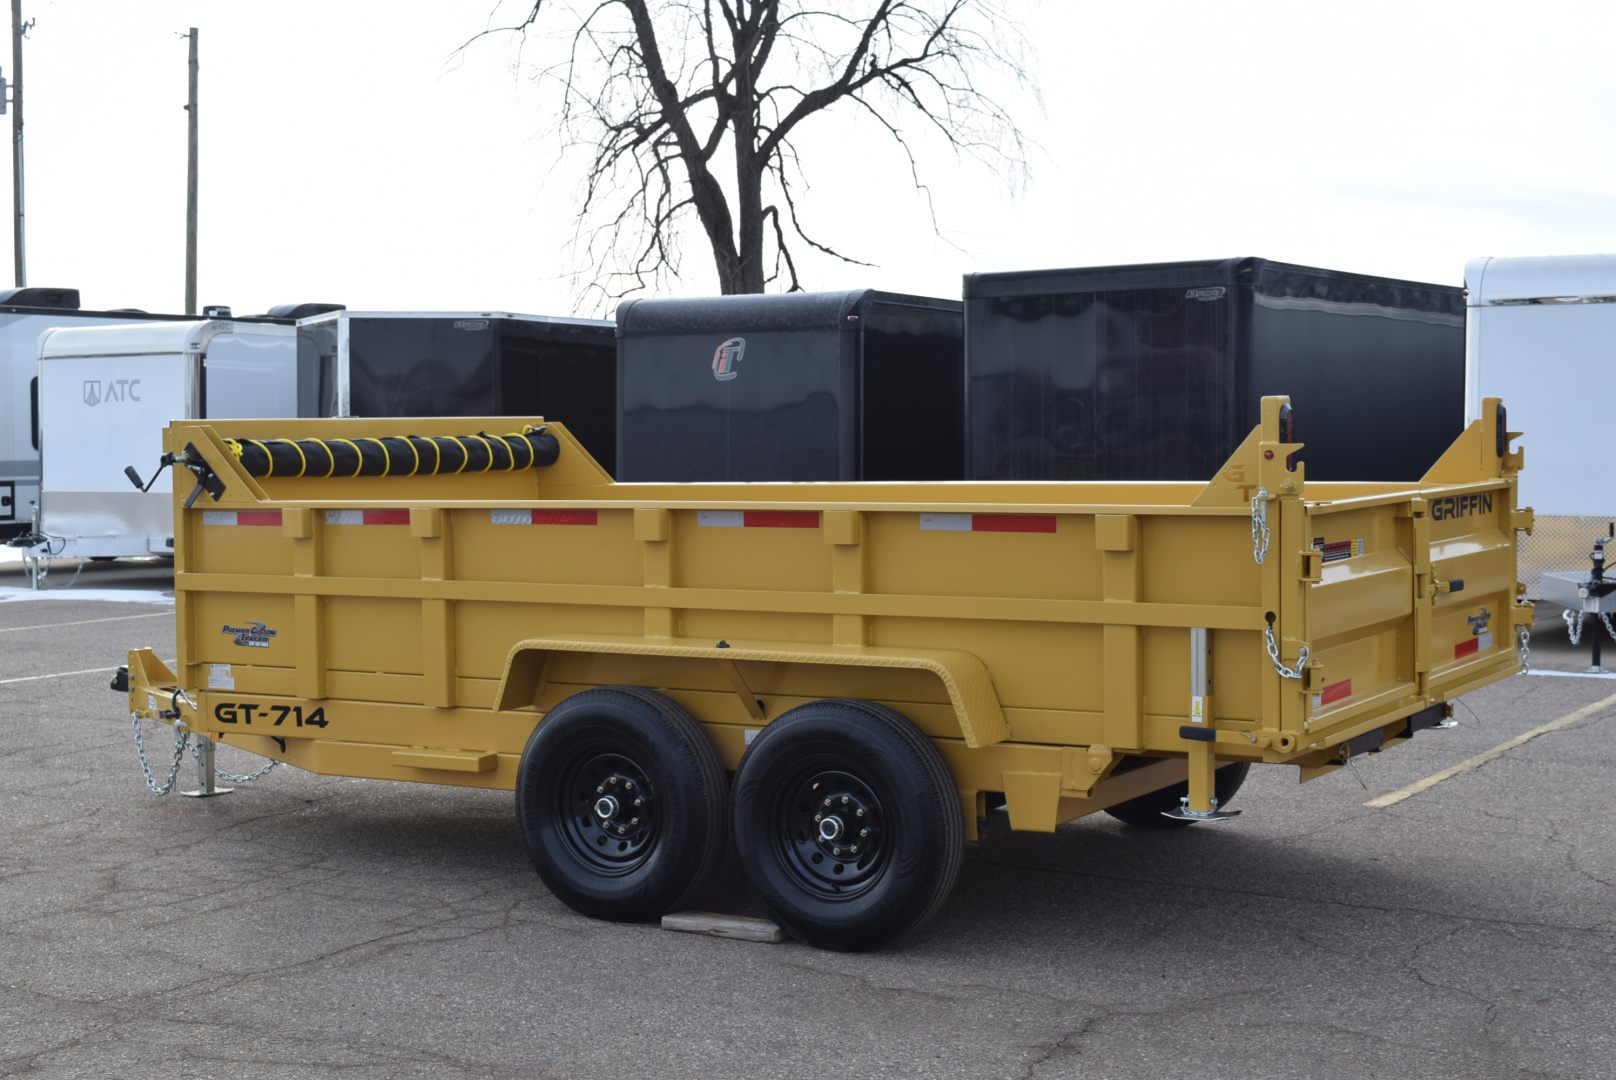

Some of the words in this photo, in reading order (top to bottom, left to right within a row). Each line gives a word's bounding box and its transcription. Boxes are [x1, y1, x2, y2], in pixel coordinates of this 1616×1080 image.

[217, 323, 230, 331] ATC
[104, 379, 141, 402] ATC
[1431, 493, 1492, 521] GRIFFIN
[222, 625, 250, 634] PREMIER
[250, 627, 277, 636] CUSTOM
[214, 703, 329, 729] GT-714
[527, 763, 541, 831] RAMBLER
[658, 772, 682, 872] TASKMASTER
